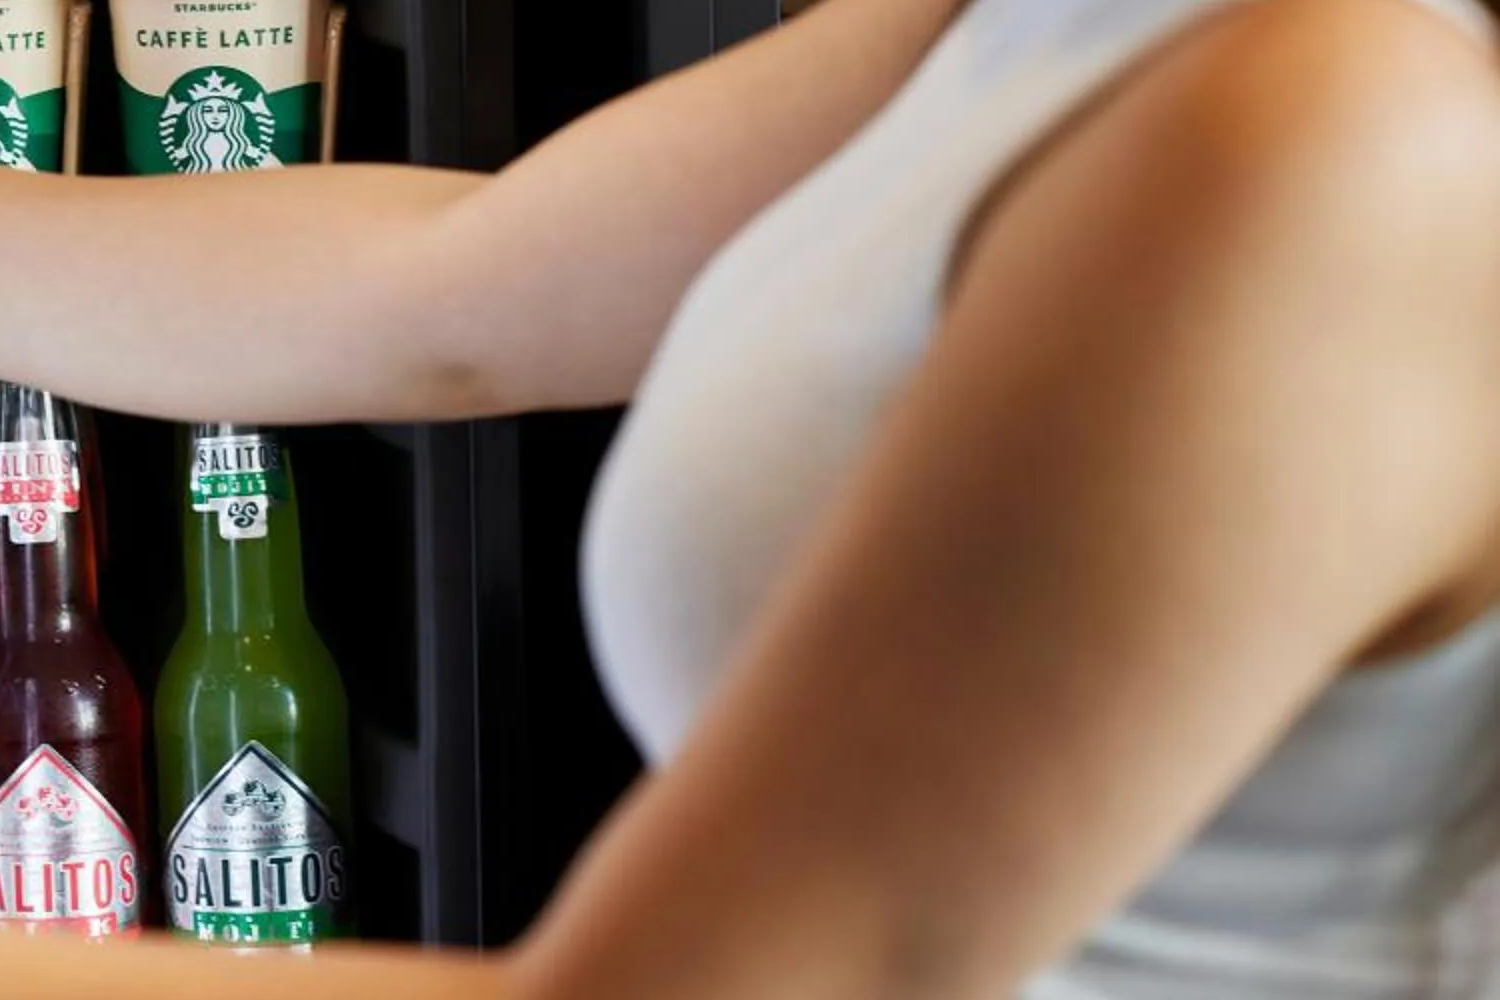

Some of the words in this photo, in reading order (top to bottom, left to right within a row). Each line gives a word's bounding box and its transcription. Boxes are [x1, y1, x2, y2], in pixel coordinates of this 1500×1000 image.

[136, 26, 208, 49] CAFFÈ
[219, 25, 293, 49] LATTE
[173, 846, 345, 908] SALITOS
